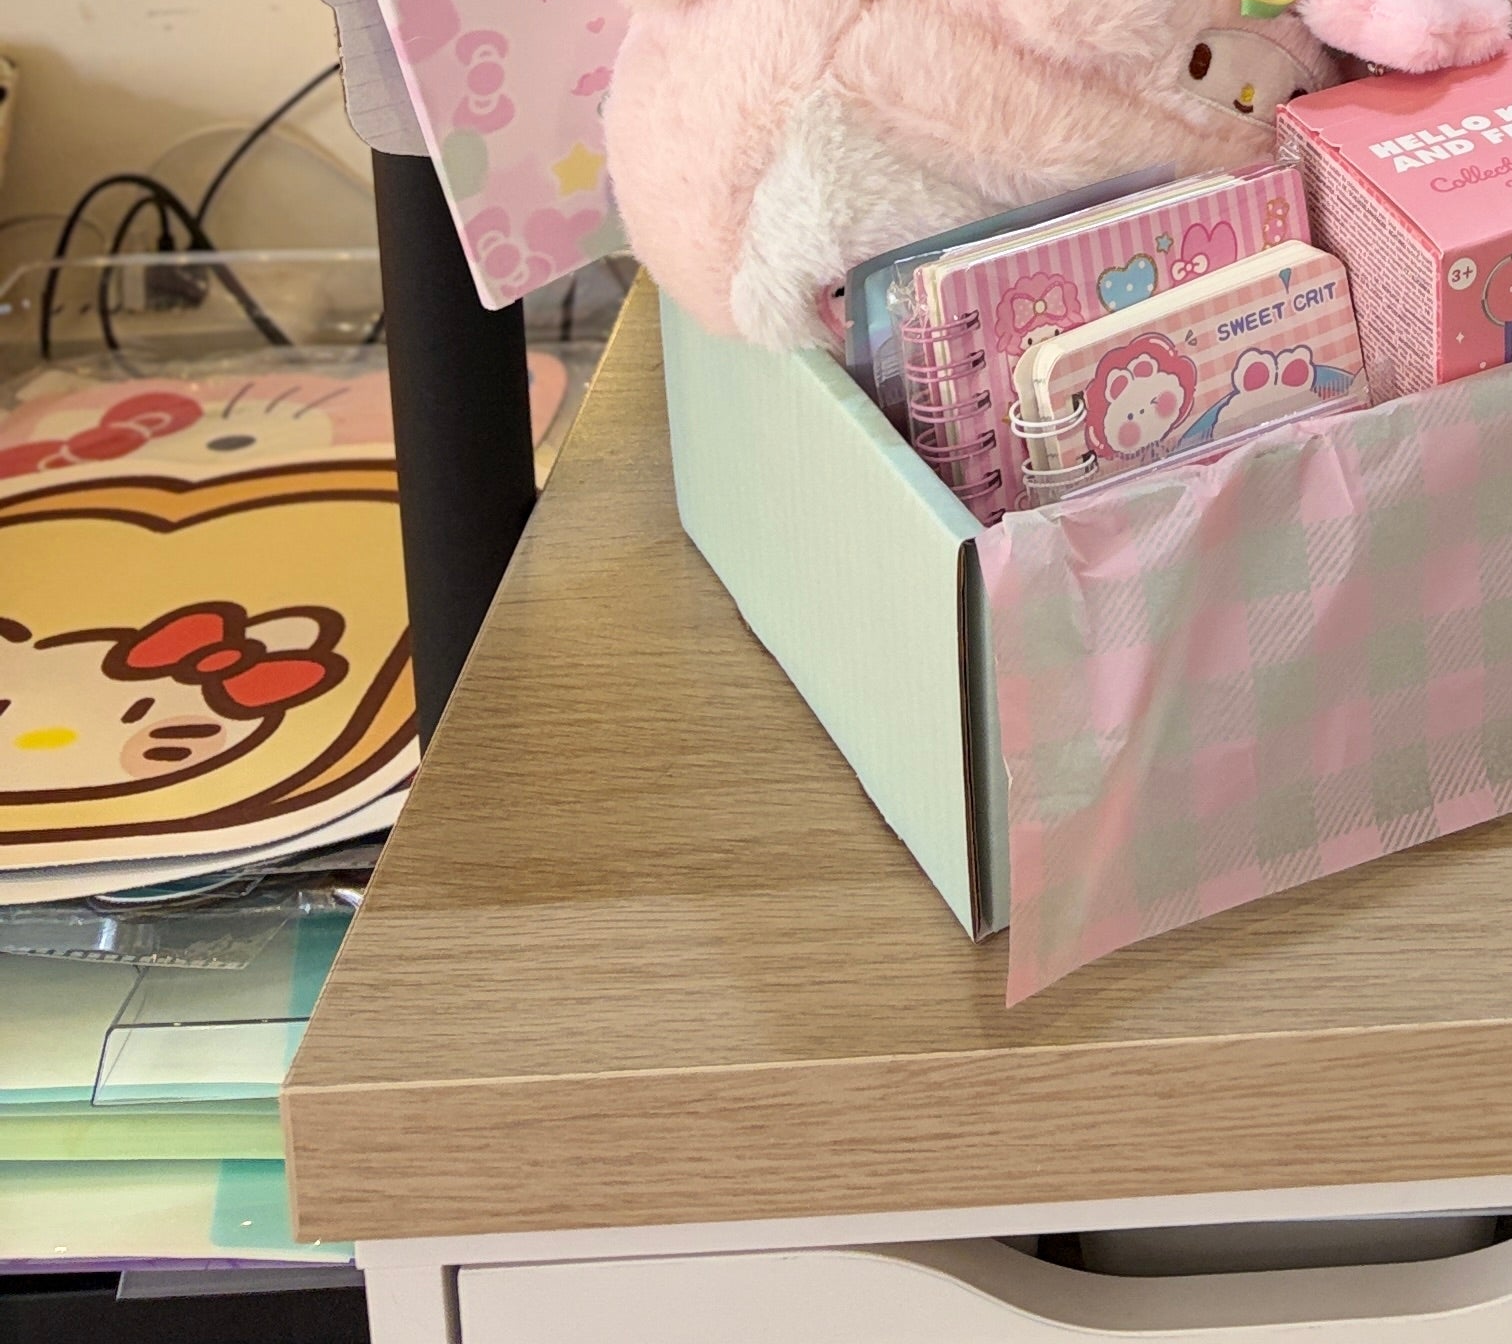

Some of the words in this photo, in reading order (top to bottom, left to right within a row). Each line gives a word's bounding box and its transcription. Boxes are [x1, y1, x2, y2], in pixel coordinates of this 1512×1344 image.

[1368, 114, 1492, 160] HELLO
[1392, 138, 1475, 174] AND
[1450, 265, 1474, 284] 3+
[1217, 301, 1286, 342] SWEET
[1293, 281, 1336, 312] CRIT
